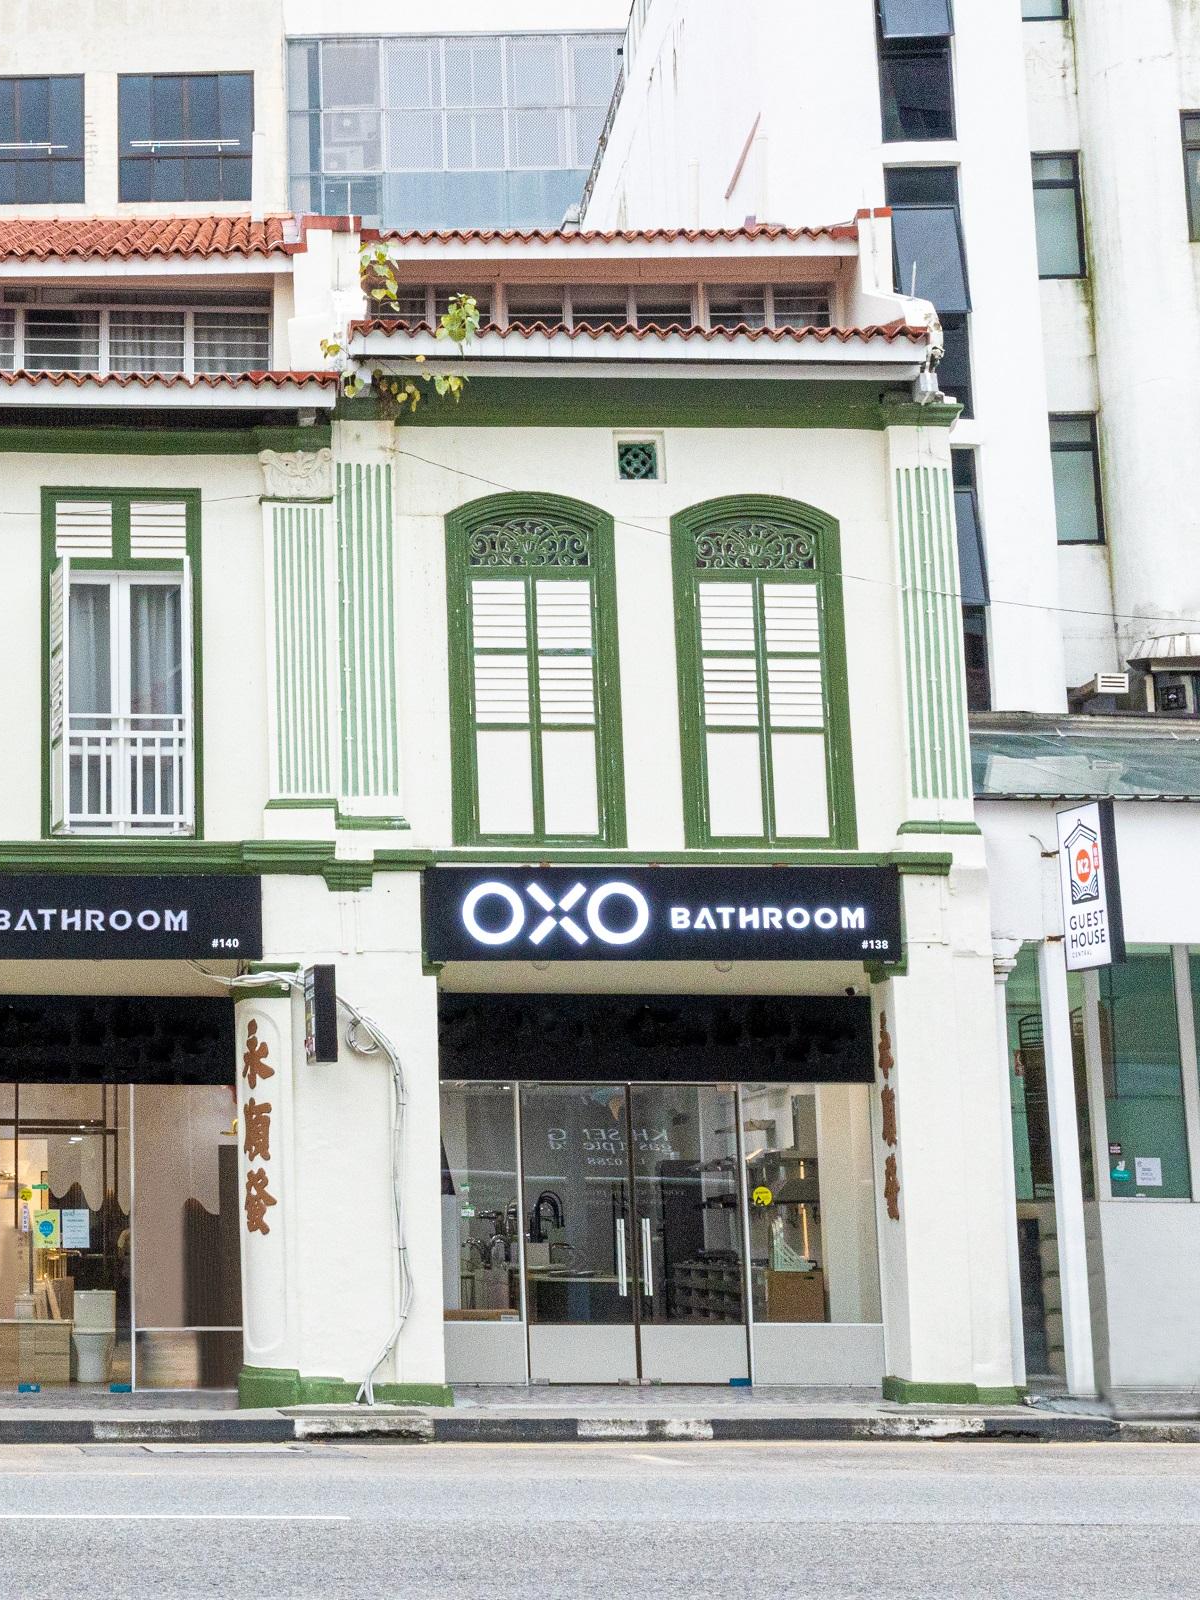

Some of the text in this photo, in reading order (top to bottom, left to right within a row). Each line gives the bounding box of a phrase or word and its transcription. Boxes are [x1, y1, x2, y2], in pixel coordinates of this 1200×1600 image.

[1077, 858, 1090, 873] K2
[462, 882, 866, 945] OXO BATHROOM
[1070, 910, 1104, 930] GUEST
[211, 938, 240, 949] #140
[861, 939, 889, 950] #138
[1071, 928, 1106, 949] HOUSE
